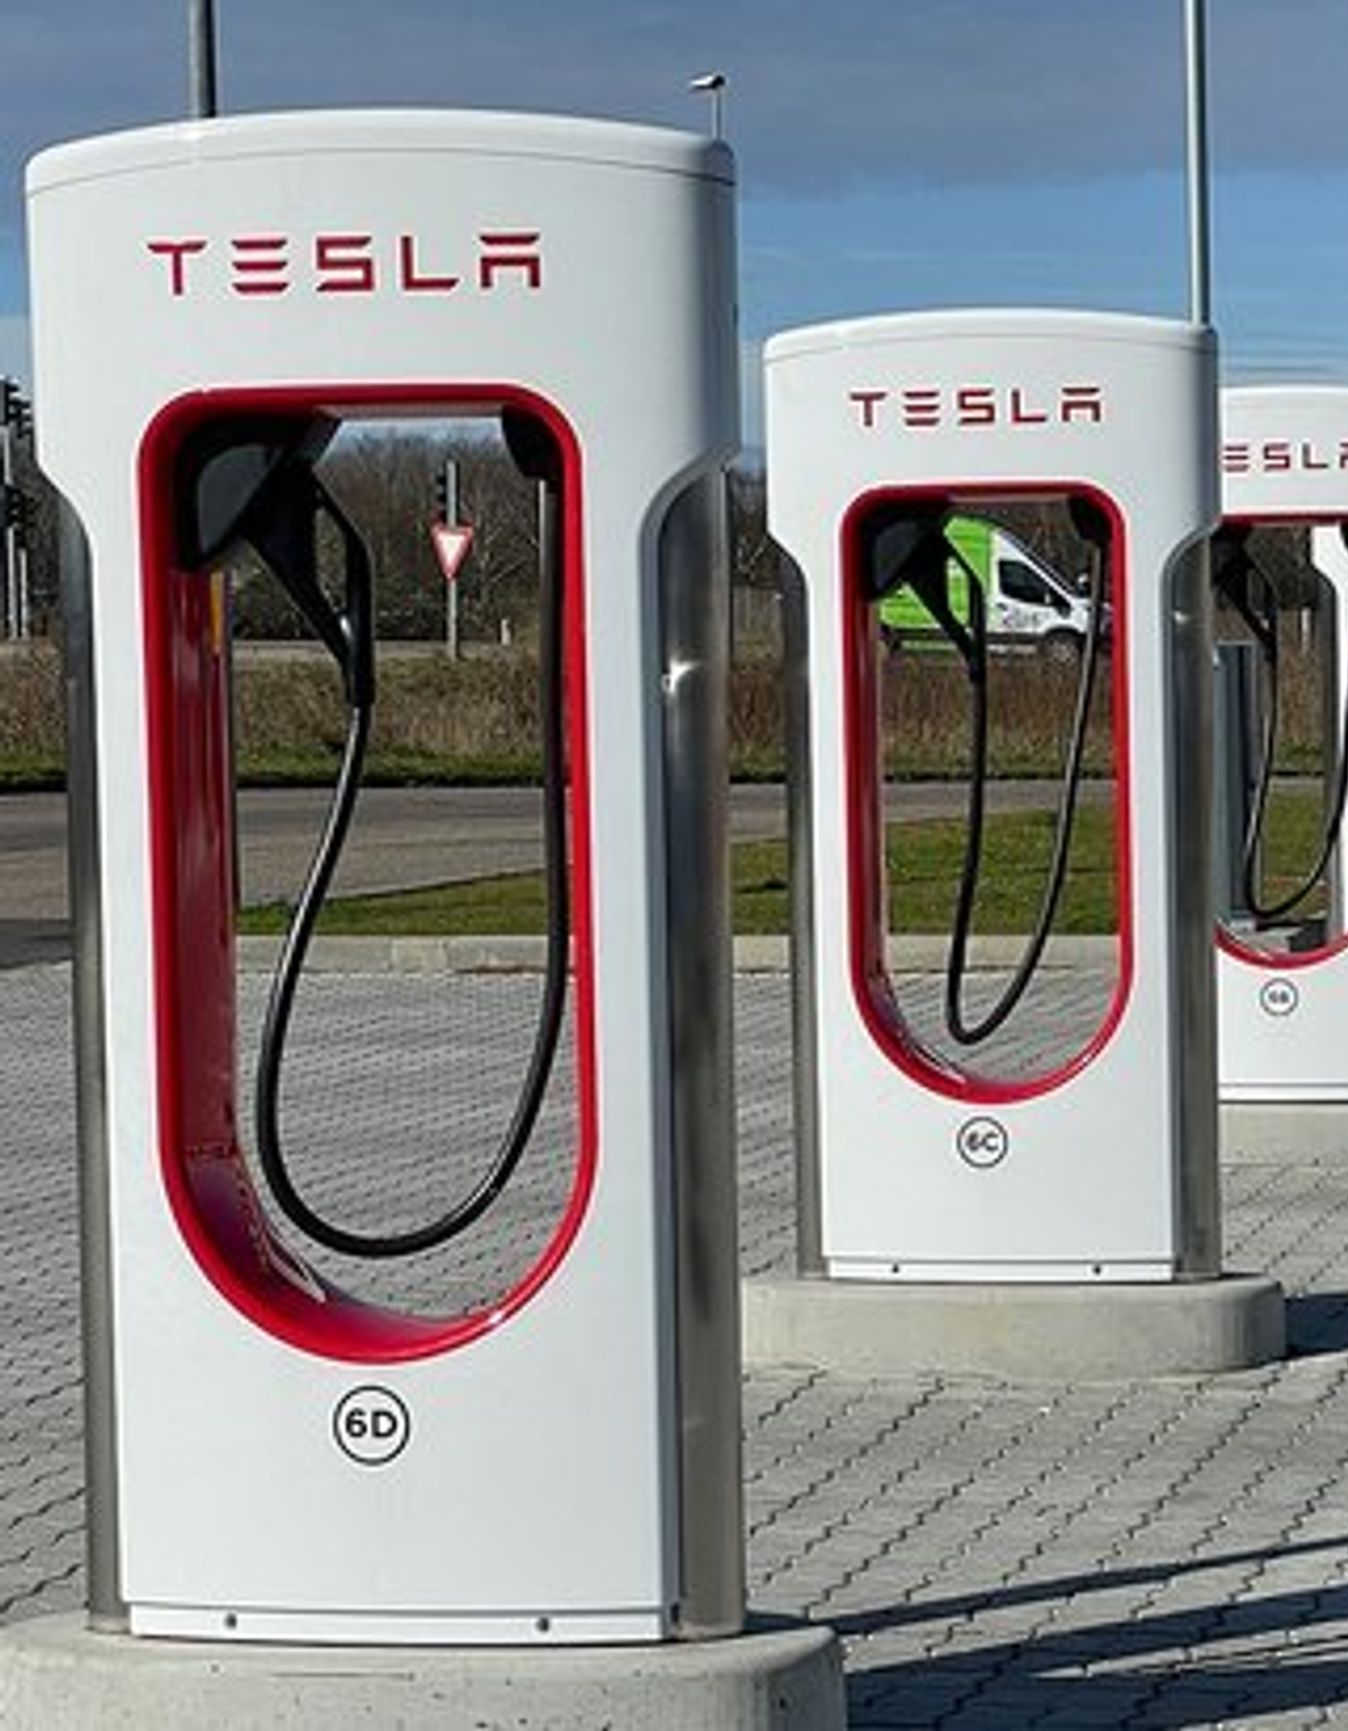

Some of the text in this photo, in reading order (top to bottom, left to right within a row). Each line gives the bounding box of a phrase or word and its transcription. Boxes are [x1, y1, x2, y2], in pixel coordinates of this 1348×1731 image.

[148, 233, 540, 295] TESLA
[850, 387, 1101, 427] TESLA
[966, 1131, 999, 1152] 6C
[345, 1407, 398, 1438] 6D
